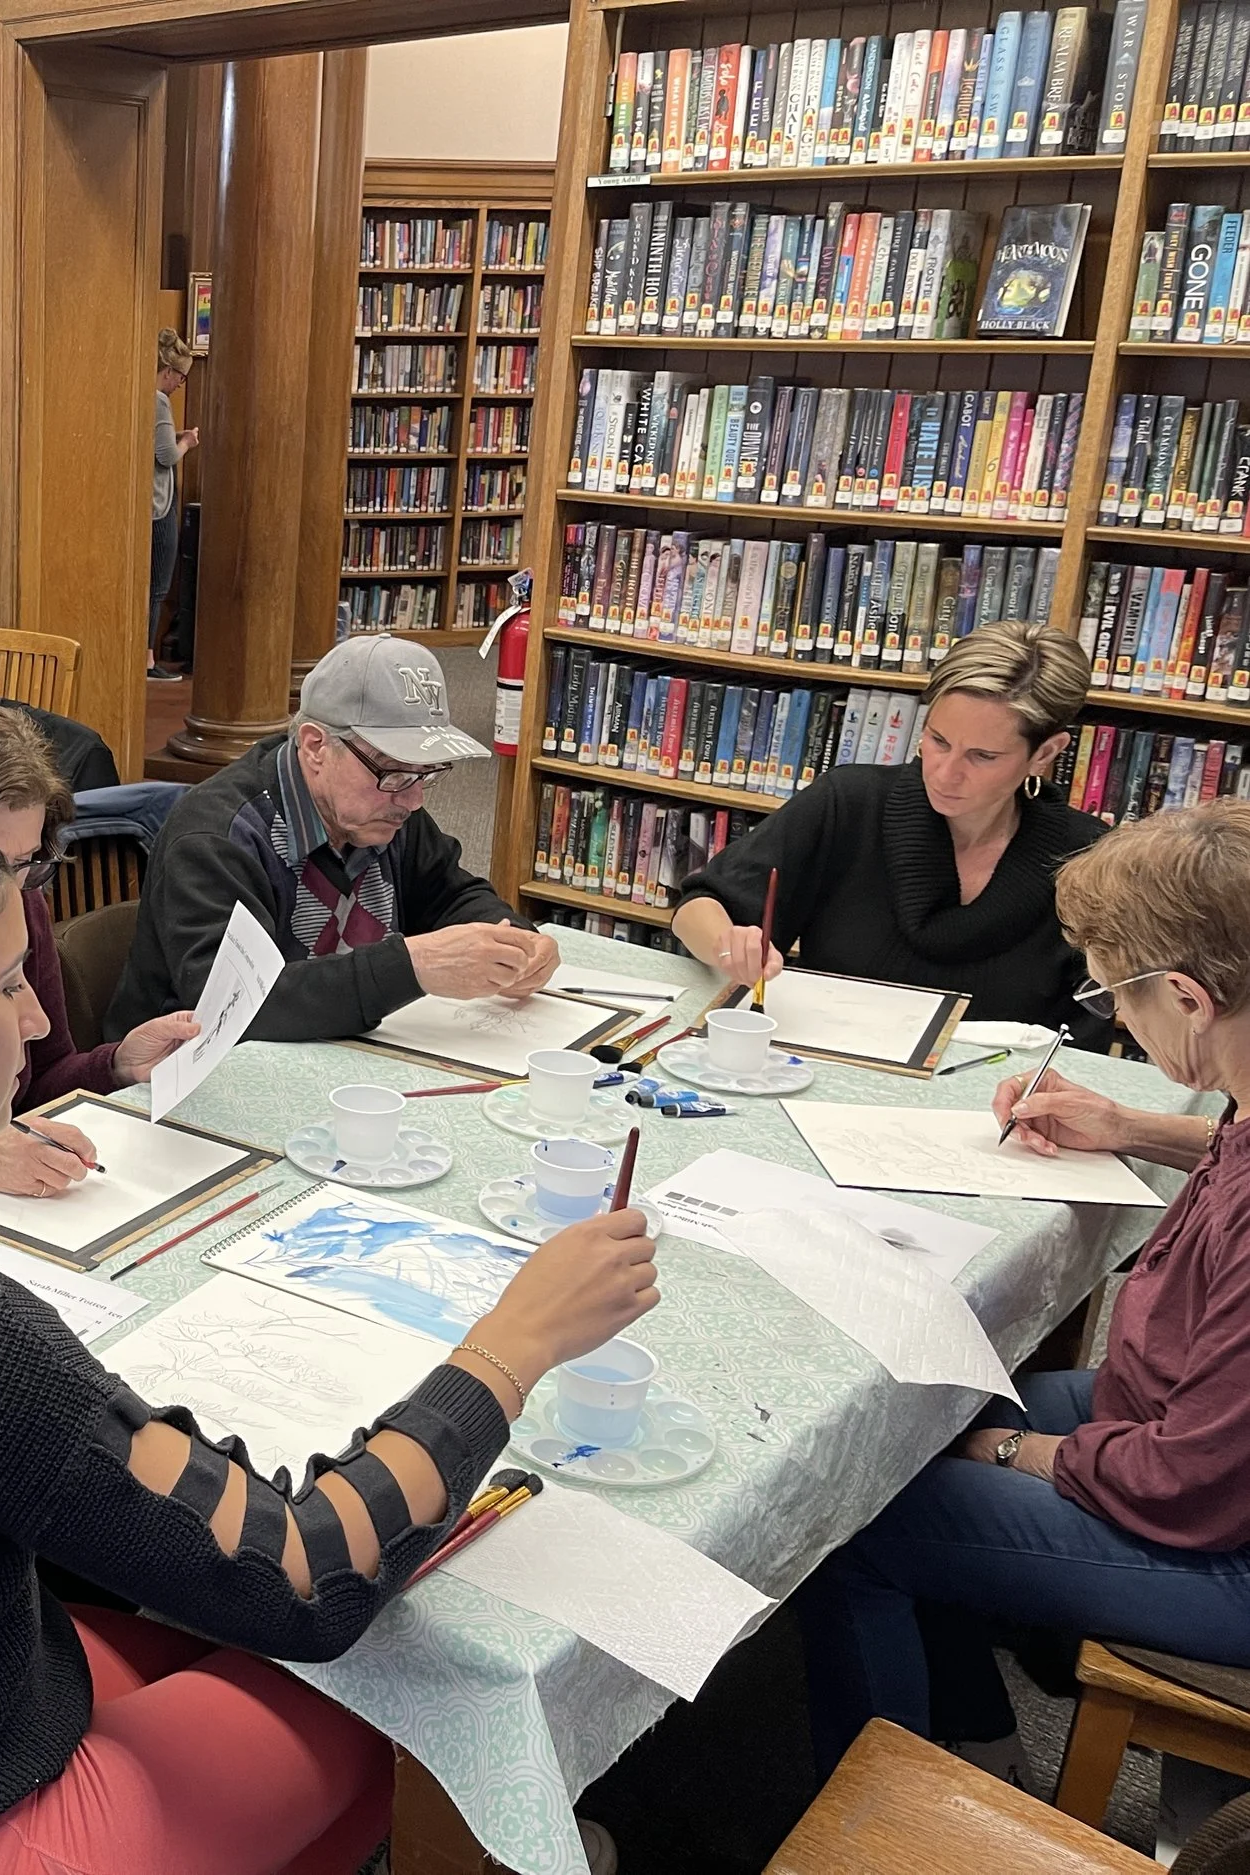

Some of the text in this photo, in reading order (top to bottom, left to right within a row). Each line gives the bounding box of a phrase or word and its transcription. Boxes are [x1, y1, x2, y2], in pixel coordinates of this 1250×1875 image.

[1047, 26, 1073, 112] REALM BREA
[1112, 14, 1138, 112] WAR STOR
[647, 233, 667, 273] NINTH
[1222, 219, 1238, 254] FEEDER
[589, 272, 601, 308] BREAK
[1182, 243, 1212, 311] GONE
[981, 320, 1050, 330] HOLLY BLACK
[633, 388, 652, 463] WHITE CA
[960, 394, 975, 427] CABOT
[724, 418, 739, 467] BEAUTY QUEE
[1134, 417, 1151, 446] Tidal
[1156, 416, 1174, 468] CRIMSON
[912, 421, 941, 489] HATE LIS
[871, 560, 886, 587] City
[981, 566, 996, 619] Clockwork
[1007, 564, 1024, 616] Clockwork
[868, 600, 882, 630] Ashe
[888, 607, 904, 633] Bon
[938, 596, 955, 621] City
[1123, 592, 1145, 644] VAMPIRE
[1095, 605, 1117, 658] EVIL GENI
[398, 667, 444, 717] NY
[568, 664, 583, 691] Lady
[611, 701, 623, 733] AIRMAN
[52, 1288, 77, 1301] Miller
